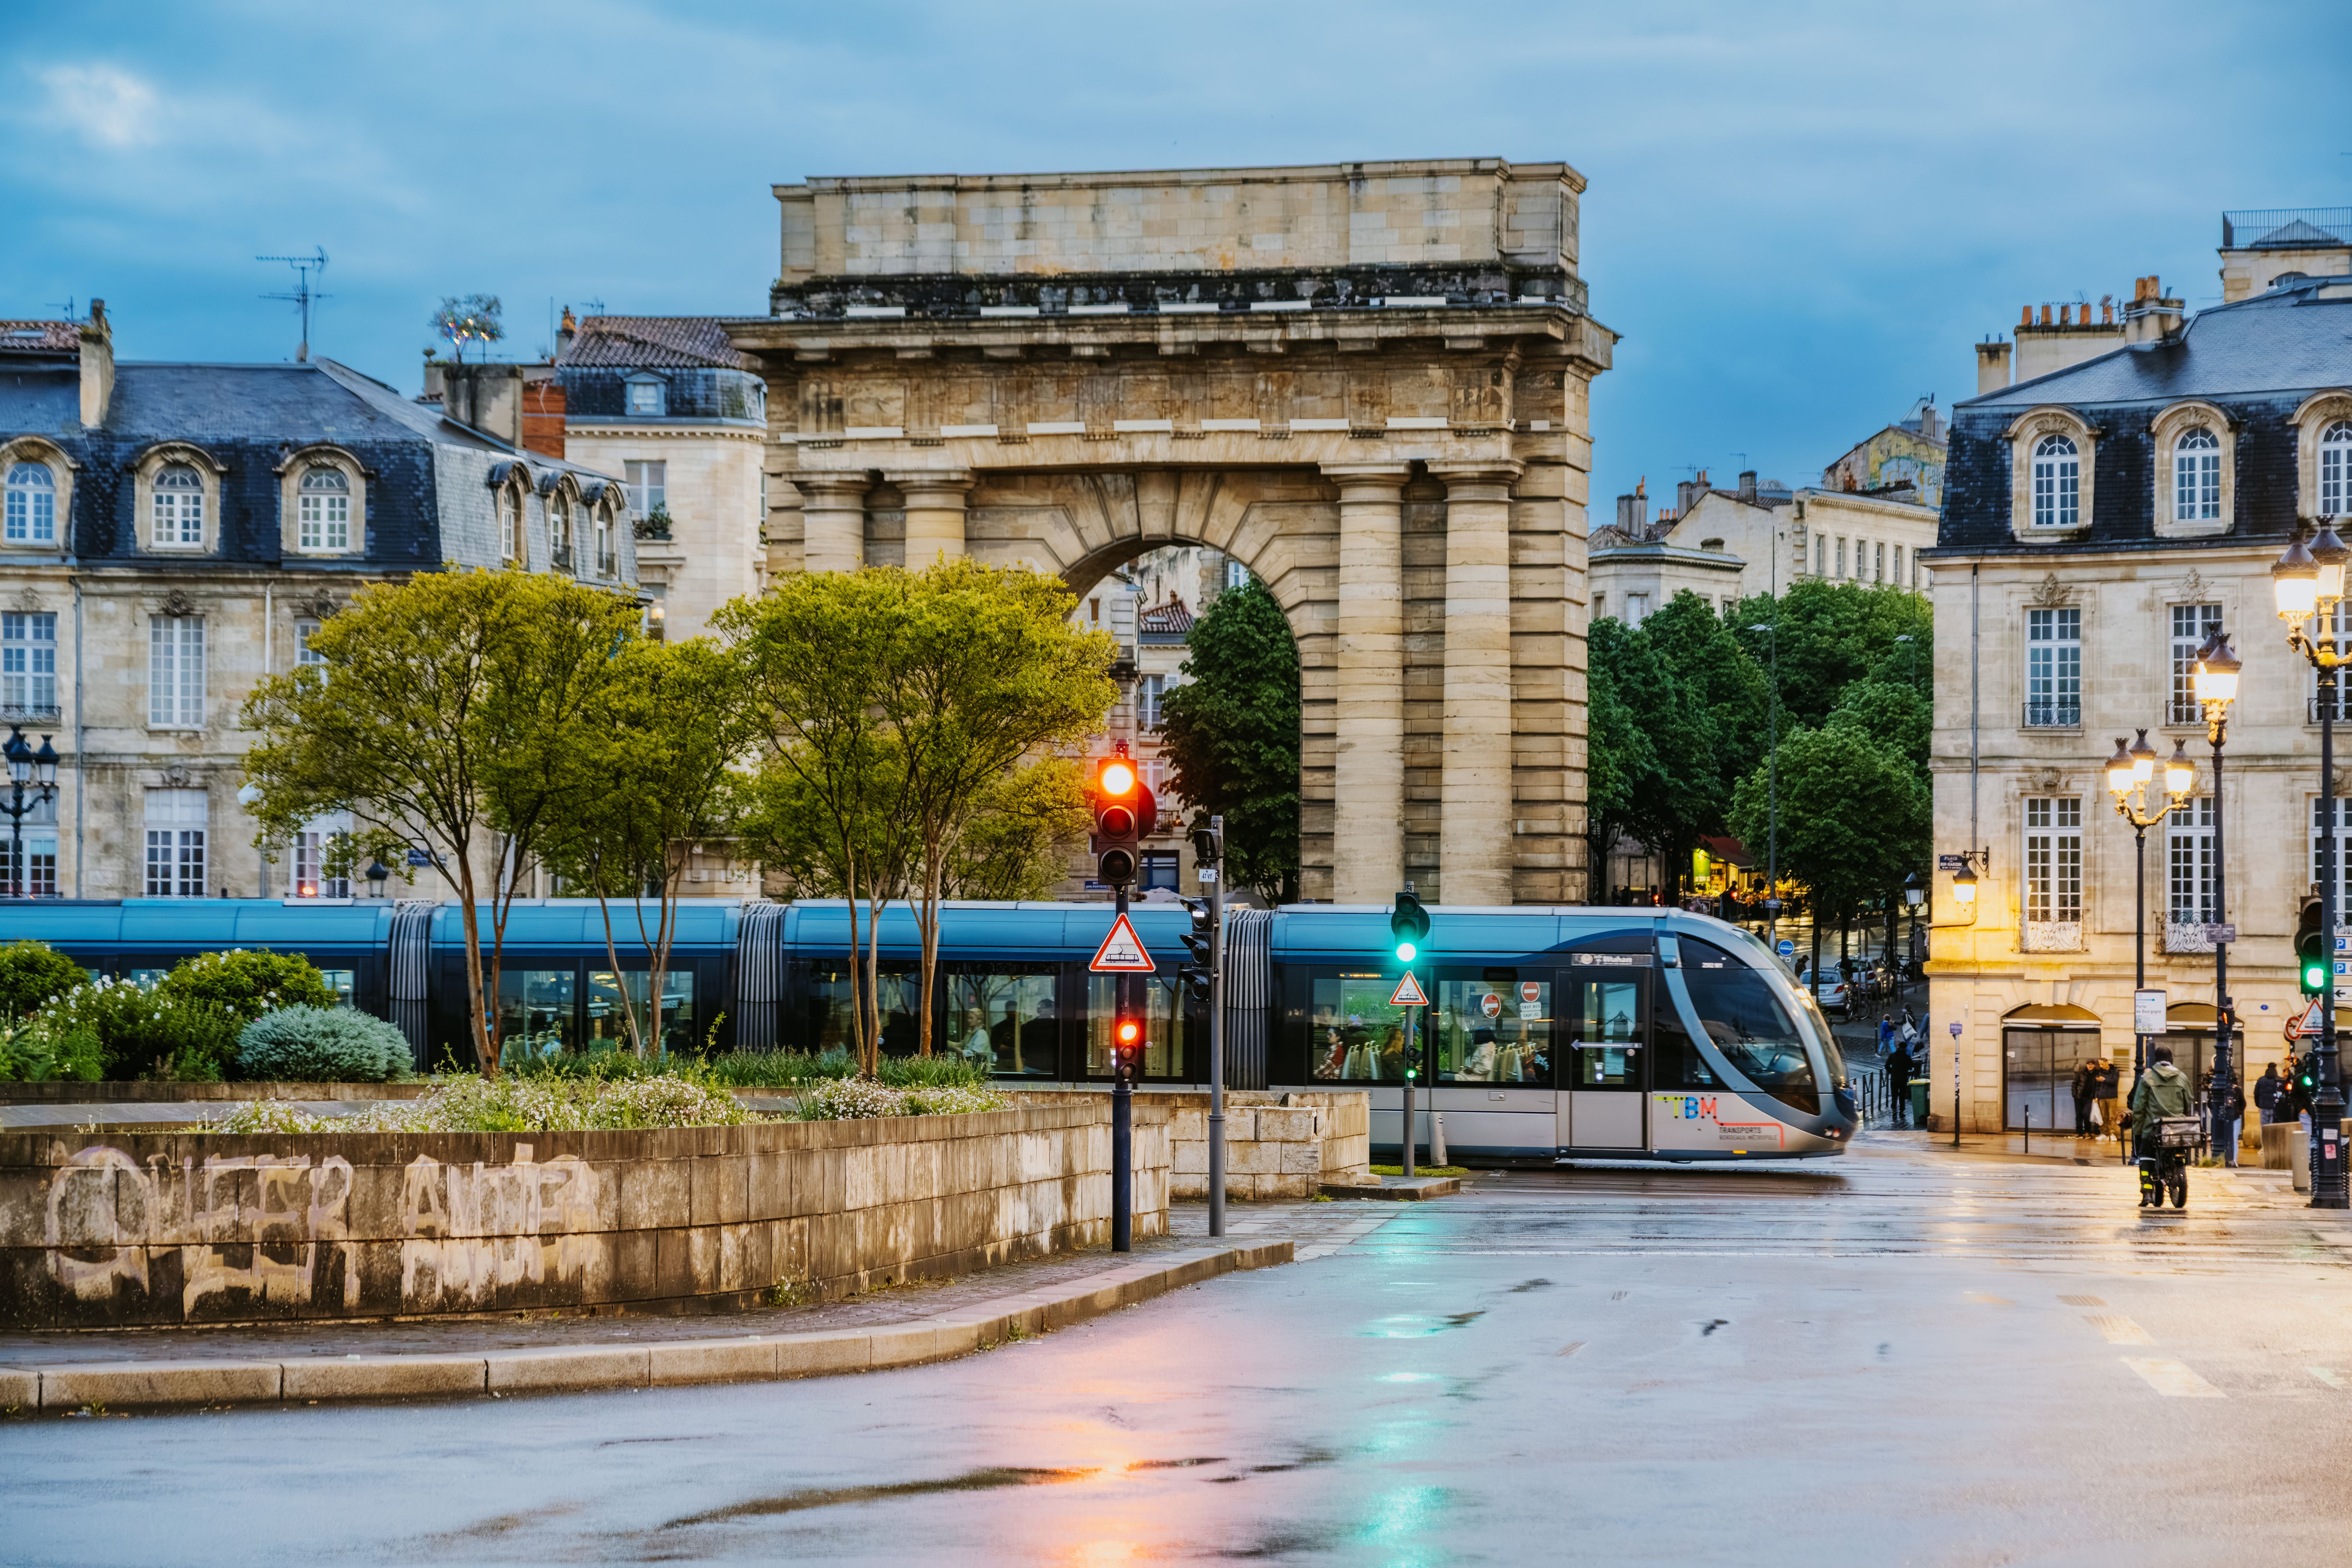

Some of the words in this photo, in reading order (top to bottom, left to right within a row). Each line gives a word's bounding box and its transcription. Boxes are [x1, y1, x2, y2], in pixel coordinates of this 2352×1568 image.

[2336, 939, 2344, 949] P
[2337, 964, 2344, 973] P
[1654, 1097, 1717, 1119] TBM
